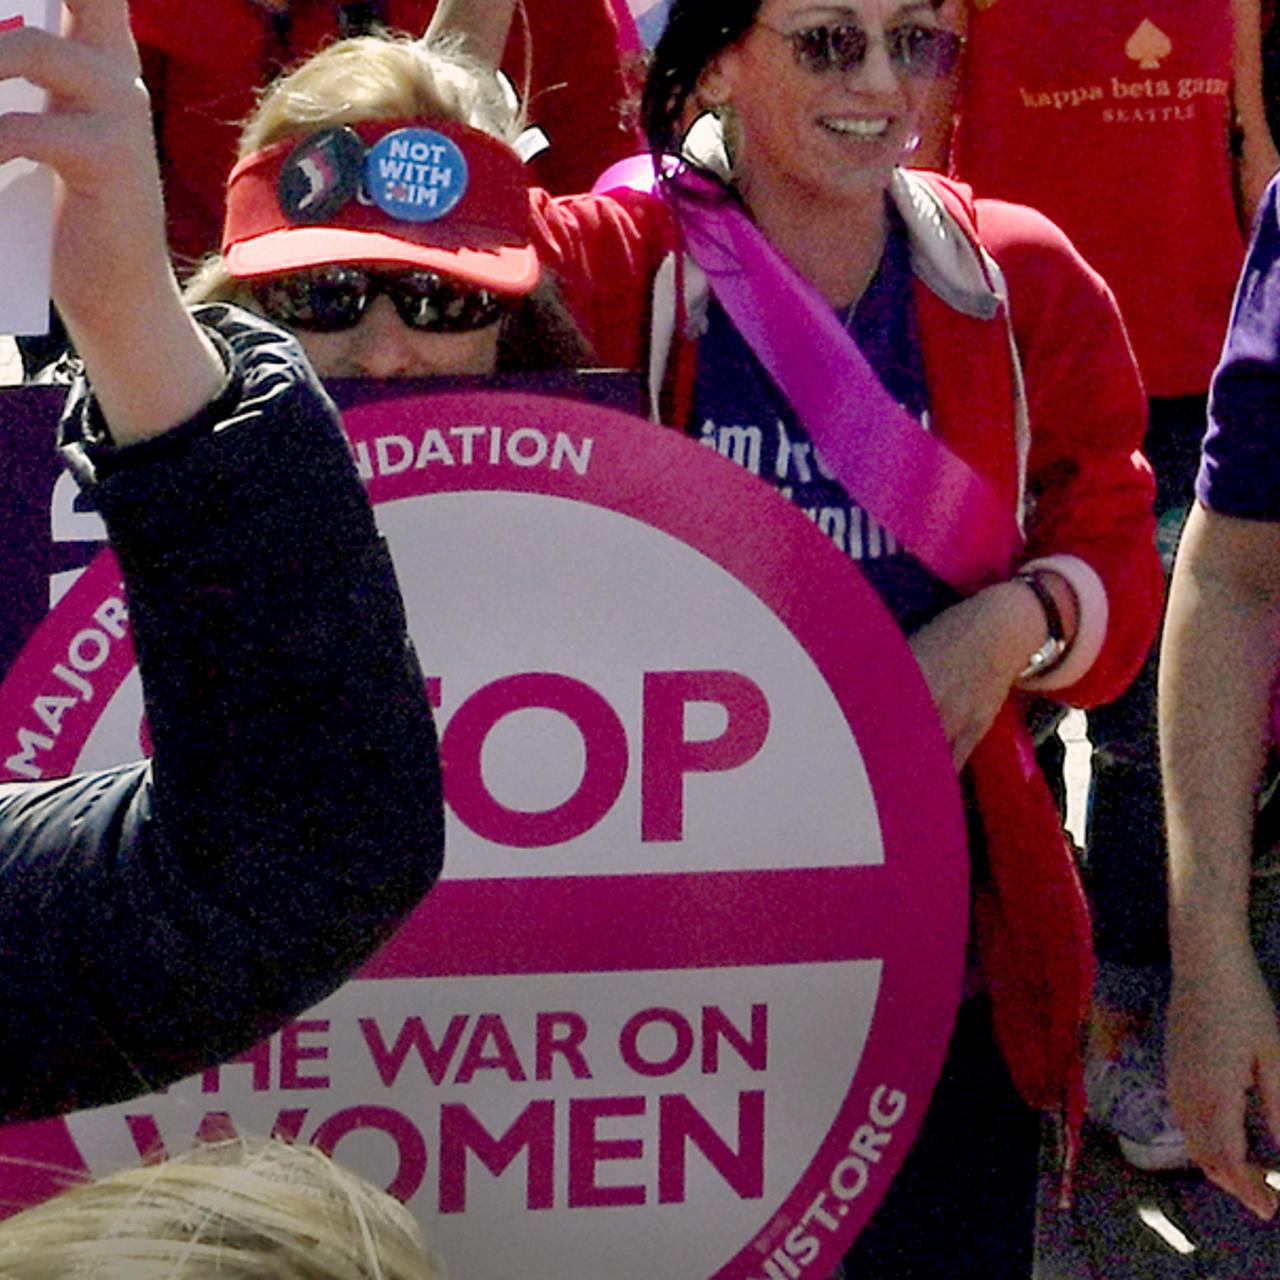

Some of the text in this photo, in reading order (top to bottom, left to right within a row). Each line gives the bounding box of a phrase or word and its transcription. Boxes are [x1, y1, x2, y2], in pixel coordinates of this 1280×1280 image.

[1019, 86, 1104, 111] kappa
[1109, 77, 1171, 100] beta
[1101, 103, 1197, 124] SEATTLE
[389, 138, 446, 164] NOT
[377, 157, 453, 189] WITH
[432, 669, 772, 850] OP
[202, 1002, 770, 1096] HE WAR ON
